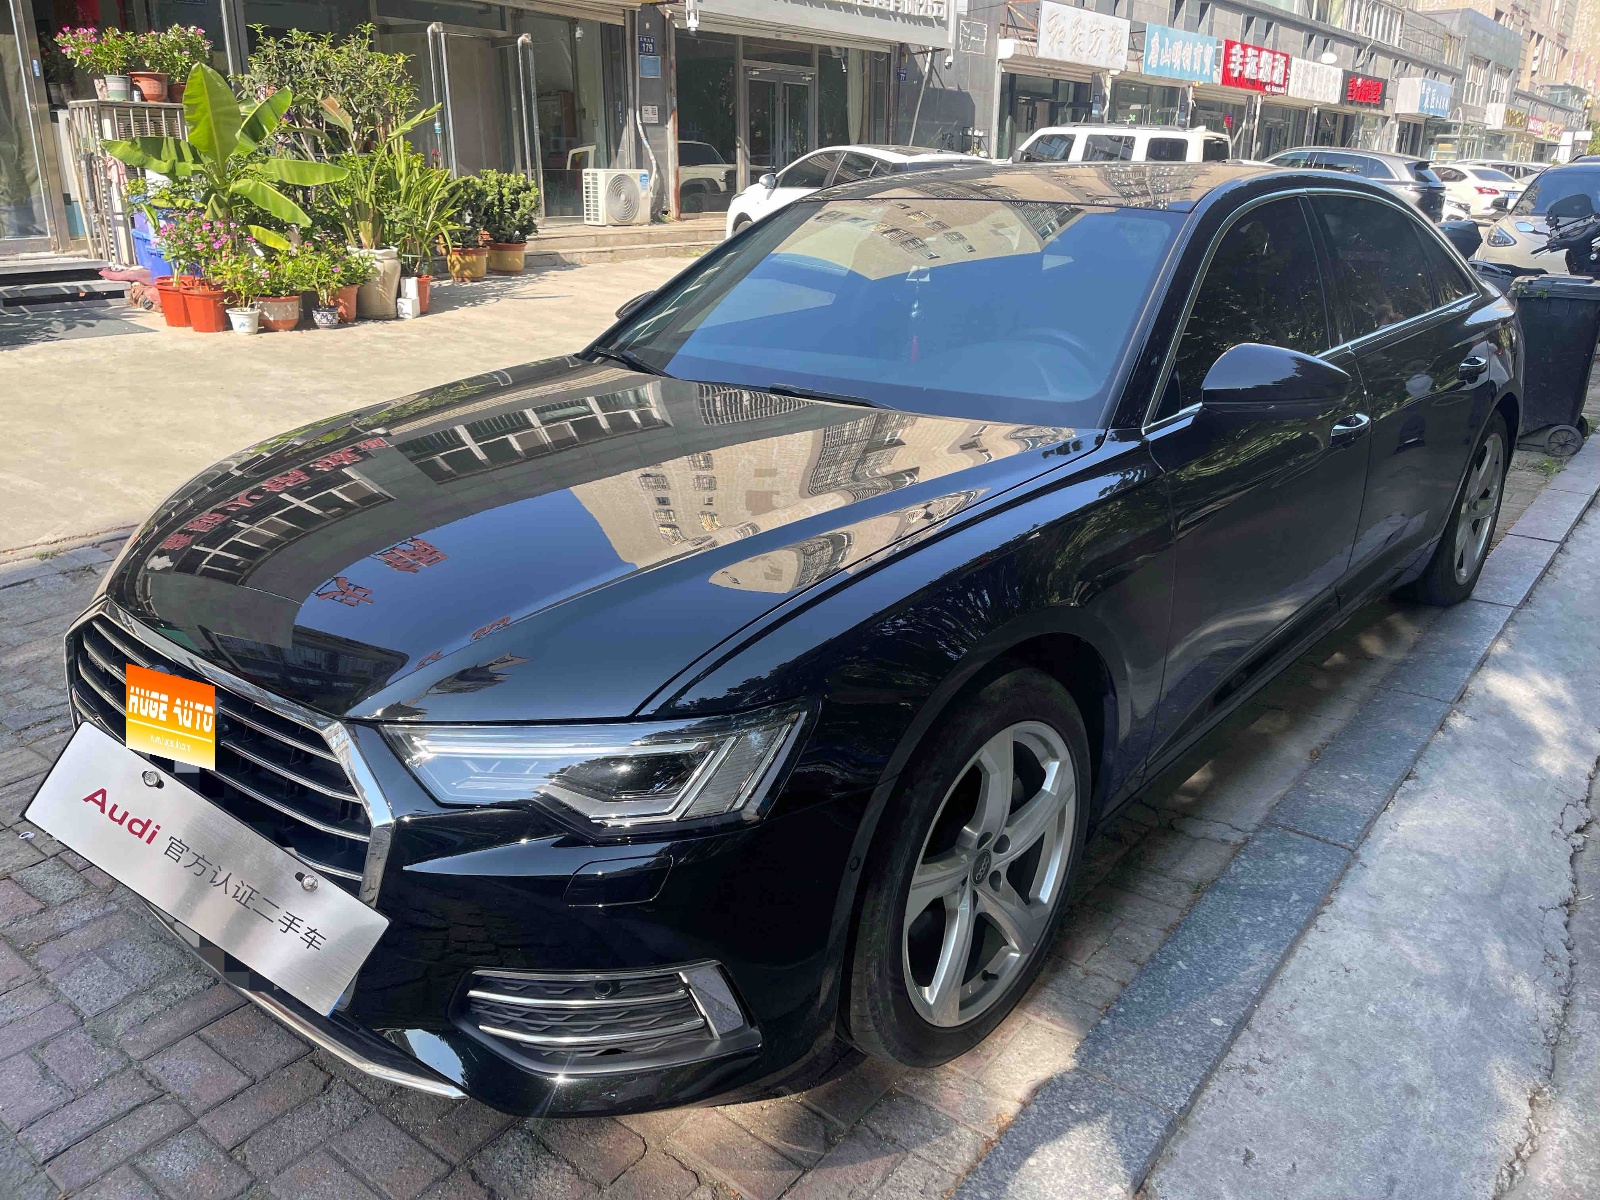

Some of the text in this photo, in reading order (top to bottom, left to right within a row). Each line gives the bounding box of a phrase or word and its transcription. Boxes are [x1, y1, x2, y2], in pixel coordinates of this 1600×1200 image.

[642, 43, 653, 53] 179
[82, 787, 328, 952] Audi 官方认证二手车
